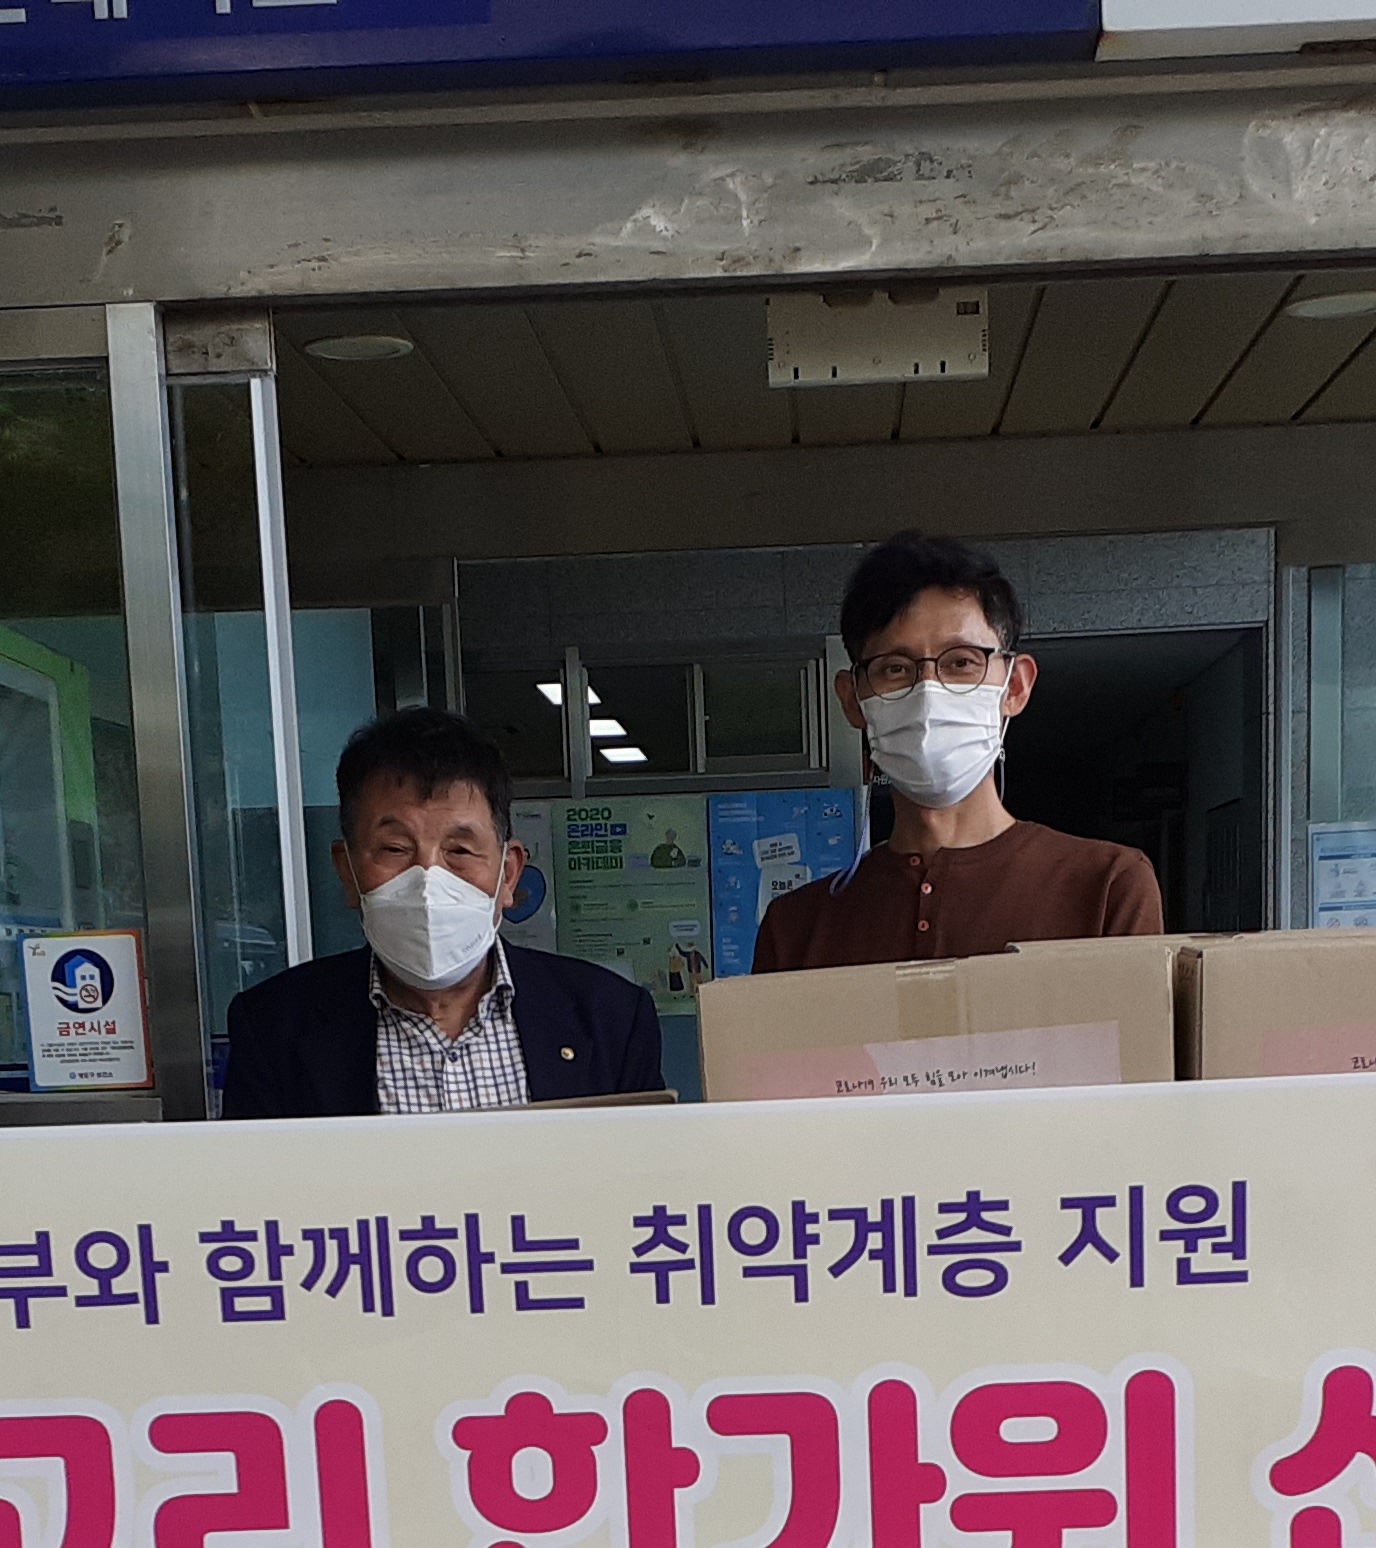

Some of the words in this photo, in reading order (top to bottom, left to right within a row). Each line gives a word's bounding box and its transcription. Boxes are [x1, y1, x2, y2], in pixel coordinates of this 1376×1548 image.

[566, 807, 612, 821] 2020
[567, 823, 608, 838] 온라인
[568, 855, 624, 870] 아카데미
[56, 1019, 117, 1037] 금연시설
[879, 1076, 898, 1090] 우리
[926, 1069, 945, 1087] 힘을
[197, 1212, 596, 1324] 함께하는
[628, 1190, 1023, 1307] 취약계층
[1057, 1180, 1250, 1289] 지원
